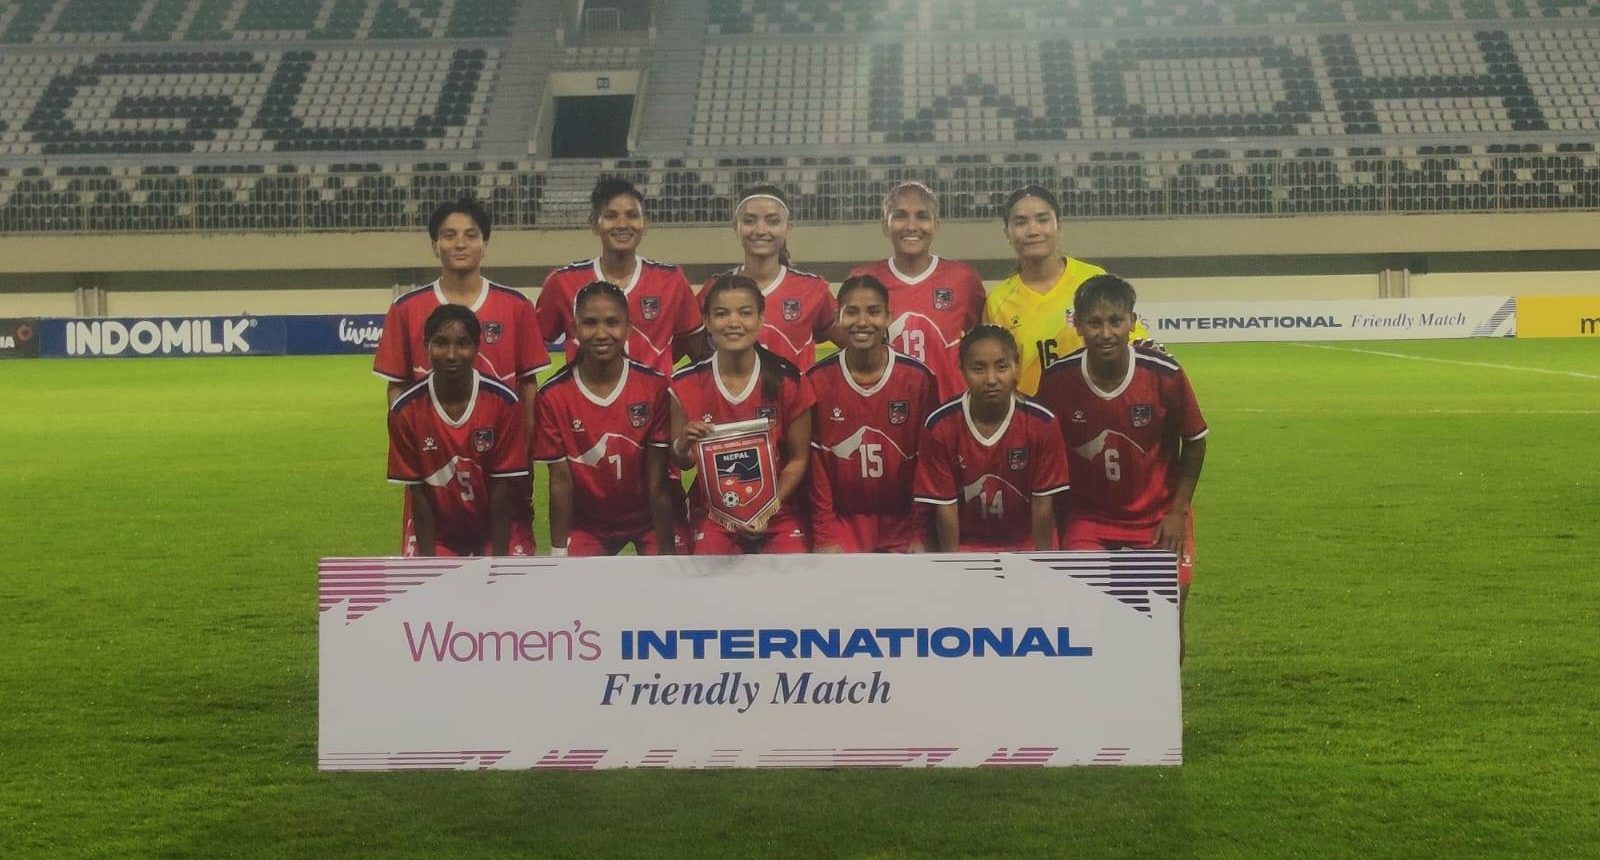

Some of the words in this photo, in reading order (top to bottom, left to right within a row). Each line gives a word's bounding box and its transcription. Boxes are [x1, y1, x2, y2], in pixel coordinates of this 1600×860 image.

[1158, 315, 1343, 331] INTERNATIONAL
[1351, 313, 1414, 330] Friendly
[1419, 312, 1466, 327] Match
[902, 329, 927, 364] 13
[1036, 338, 1059, 370] 16
[608, 454, 623, 480] 7
[723, 451, 750, 462] NEPAL
[858, 443, 884, 479] 15
[1103, 448, 1121, 481] 6
[456, 470, 475, 502] 5
[980, 490, 1004, 519] 14
[402, 619, 602, 663] Women's
[621, 627, 1094, 660] INTERNATIONAL
[600, 672, 761, 714] Friendly
[769, 671, 892, 707] Match
